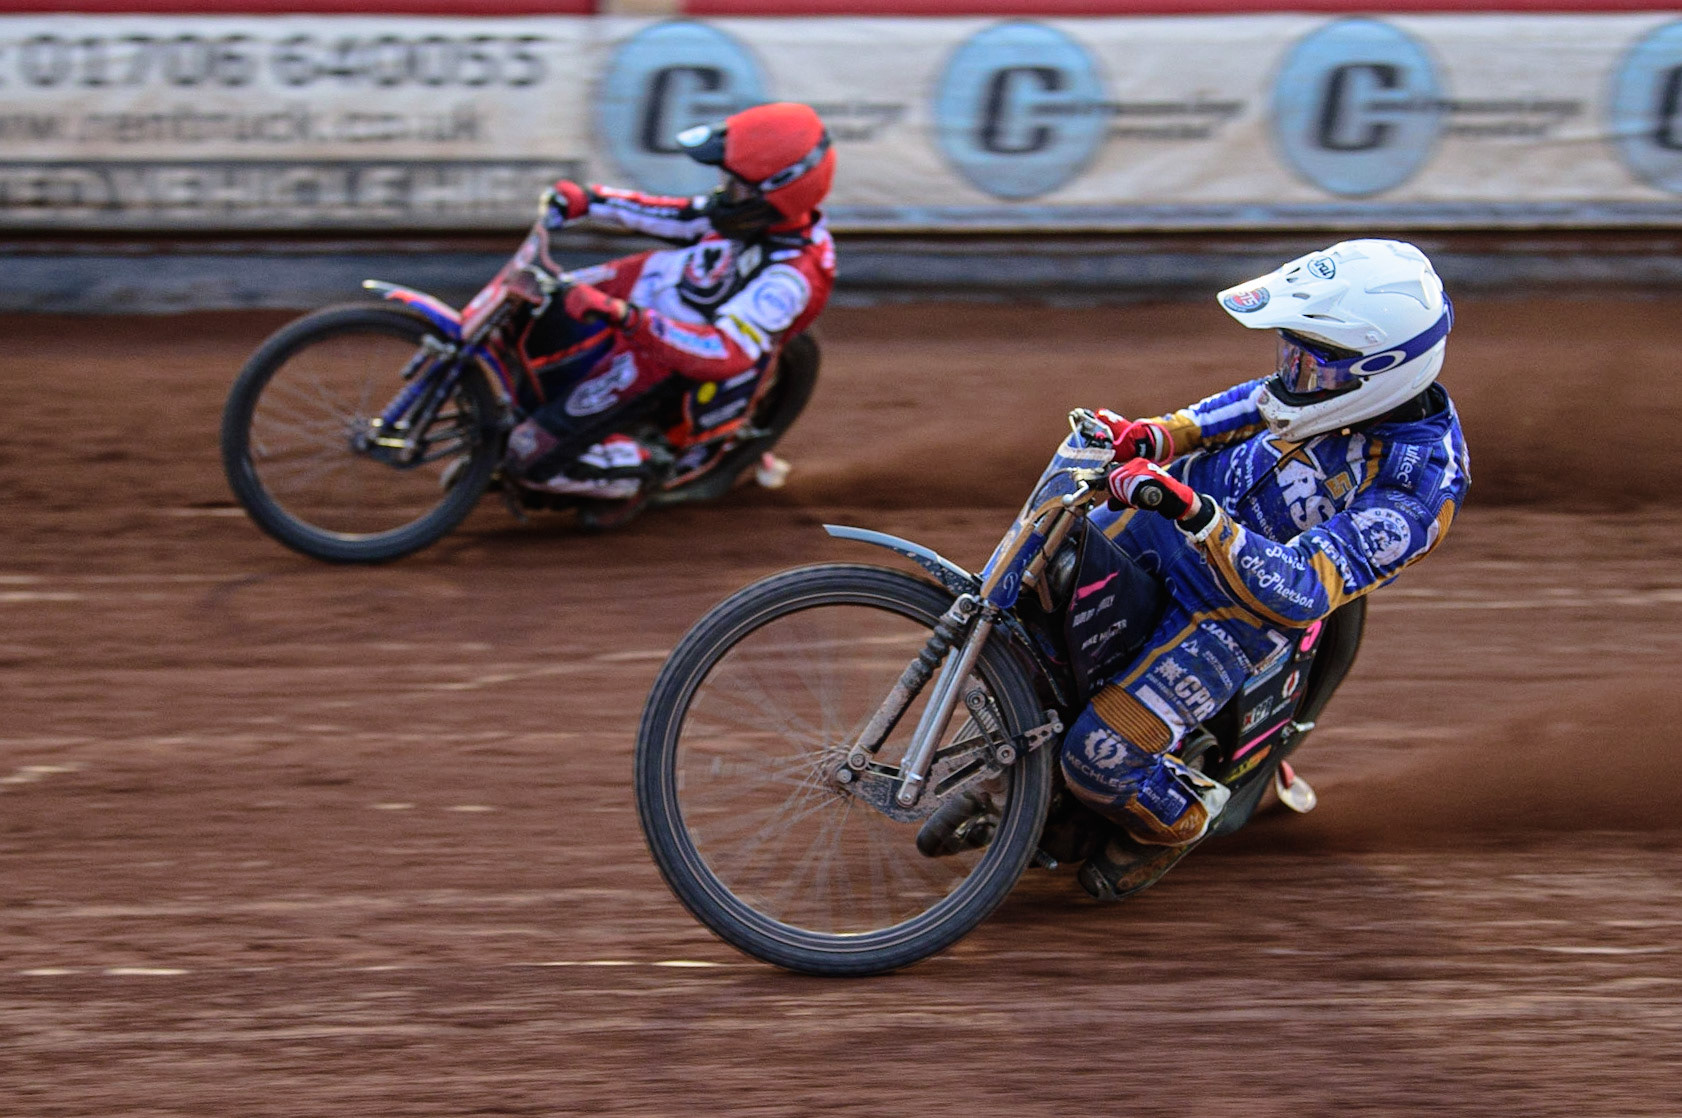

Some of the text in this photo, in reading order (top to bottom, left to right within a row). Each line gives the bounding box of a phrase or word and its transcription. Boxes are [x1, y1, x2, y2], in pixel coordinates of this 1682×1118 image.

[984, 66, 1067, 154] C
[1317, 62, 1401, 152] C
[1396, 443, 1421, 485] ultec
[1241, 555, 1315, 610] McPherson
[1265, 544, 1306, 572] David
[1201, 621, 1239, 651] JAX
[1174, 674, 1216, 723] CPR
